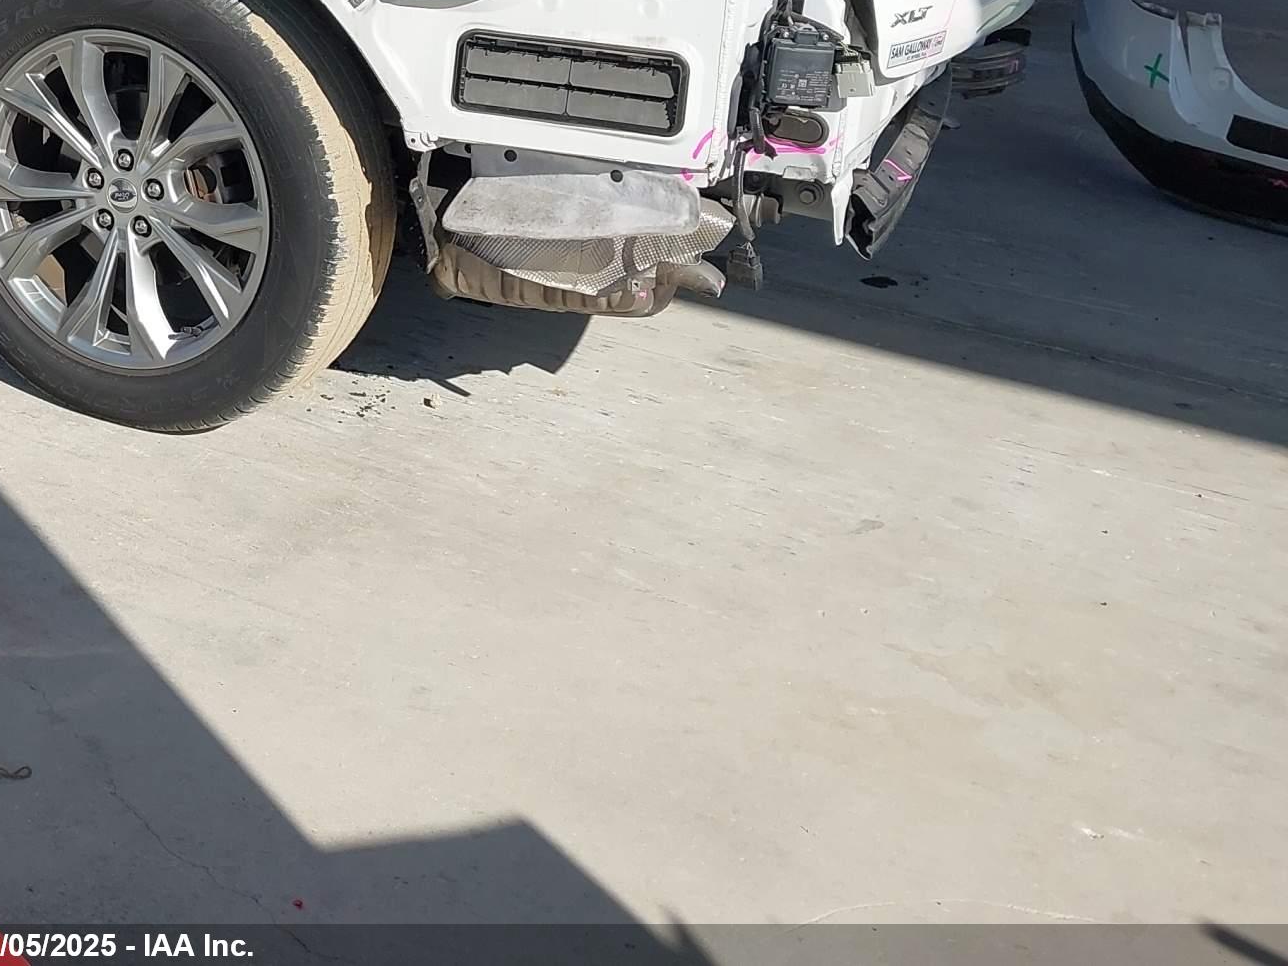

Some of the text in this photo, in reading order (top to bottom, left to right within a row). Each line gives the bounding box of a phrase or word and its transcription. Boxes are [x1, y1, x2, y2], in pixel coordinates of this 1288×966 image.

[890, 5, 933, 28] XLT
[891, 45, 904, 59] SAM
[905, 39, 932, 55] GALLOWAY
